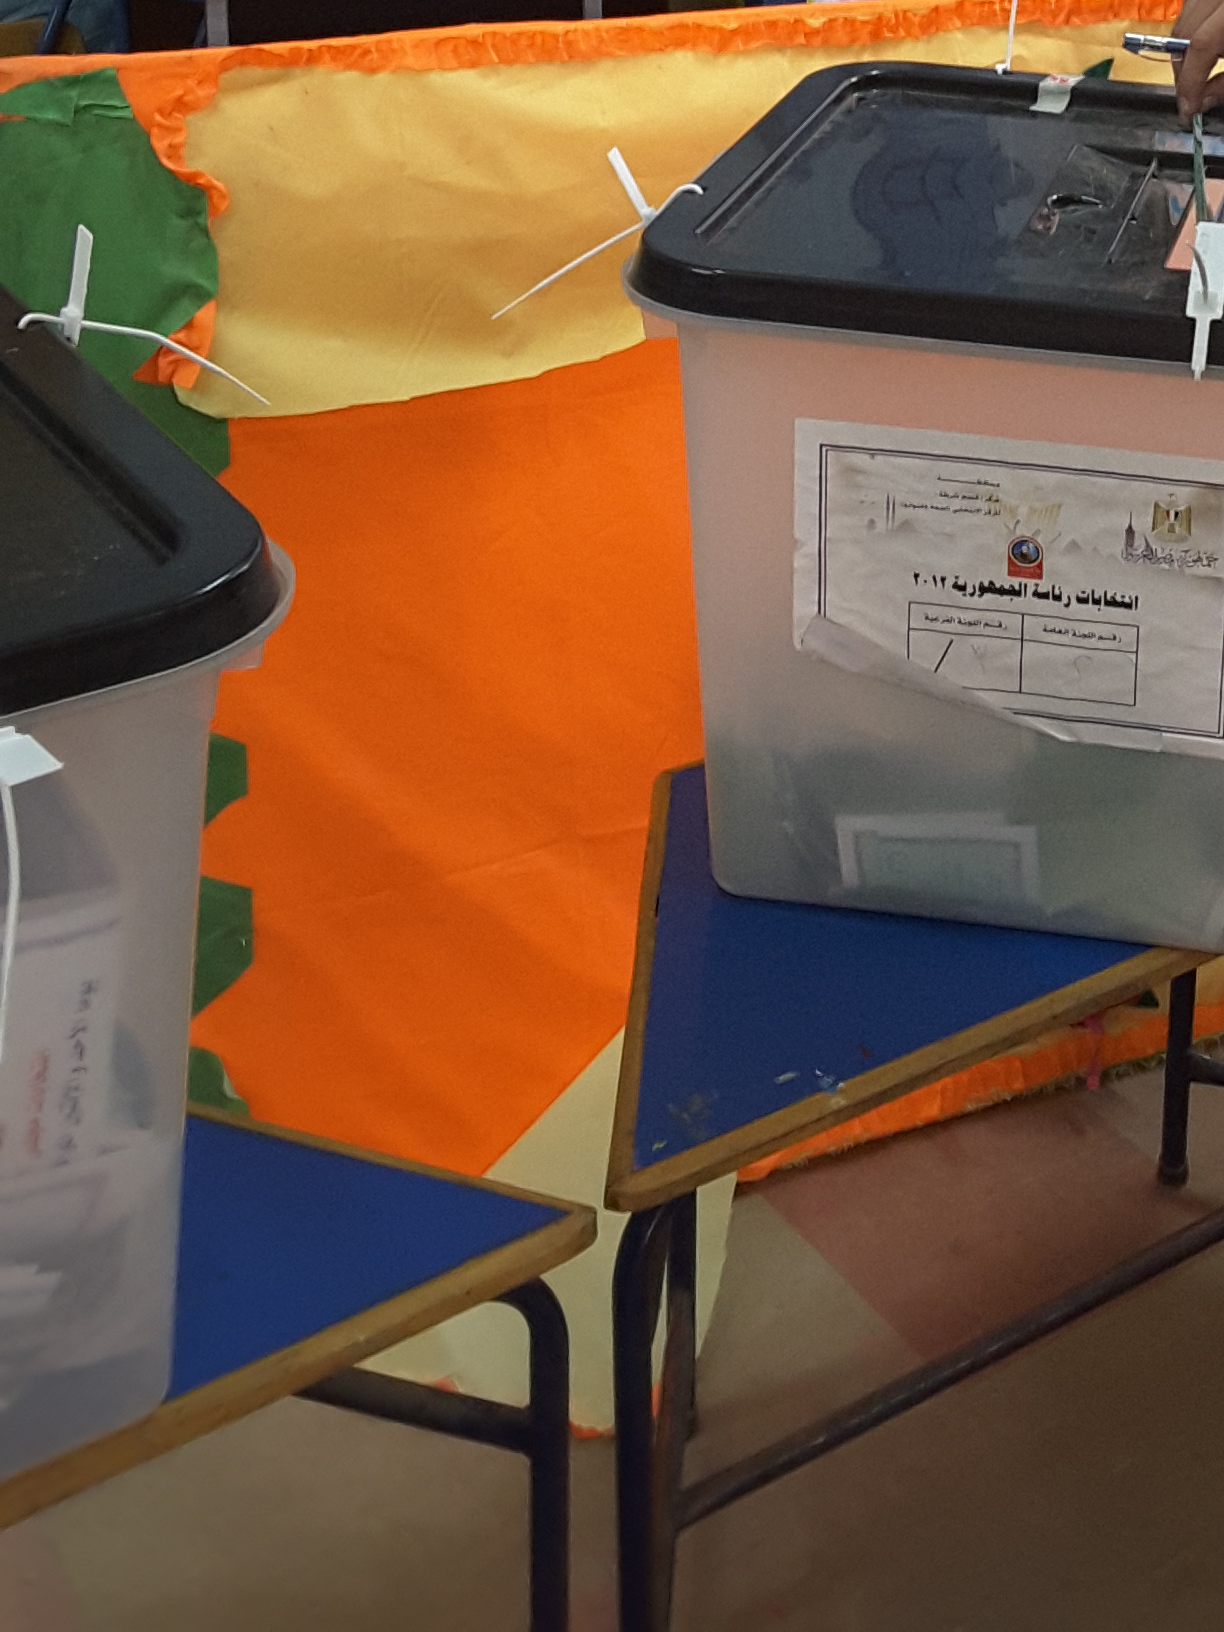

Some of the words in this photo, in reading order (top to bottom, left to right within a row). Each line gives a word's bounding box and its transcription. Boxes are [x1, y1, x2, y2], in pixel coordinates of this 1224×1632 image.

[912, 571, 947, 590] ٢٠١٢
[951, 574, 1028, 602] الجمهورية
[1031, 583, 1071, 607] رئاسة
[1075, 588, 1139, 611] انتخابات
